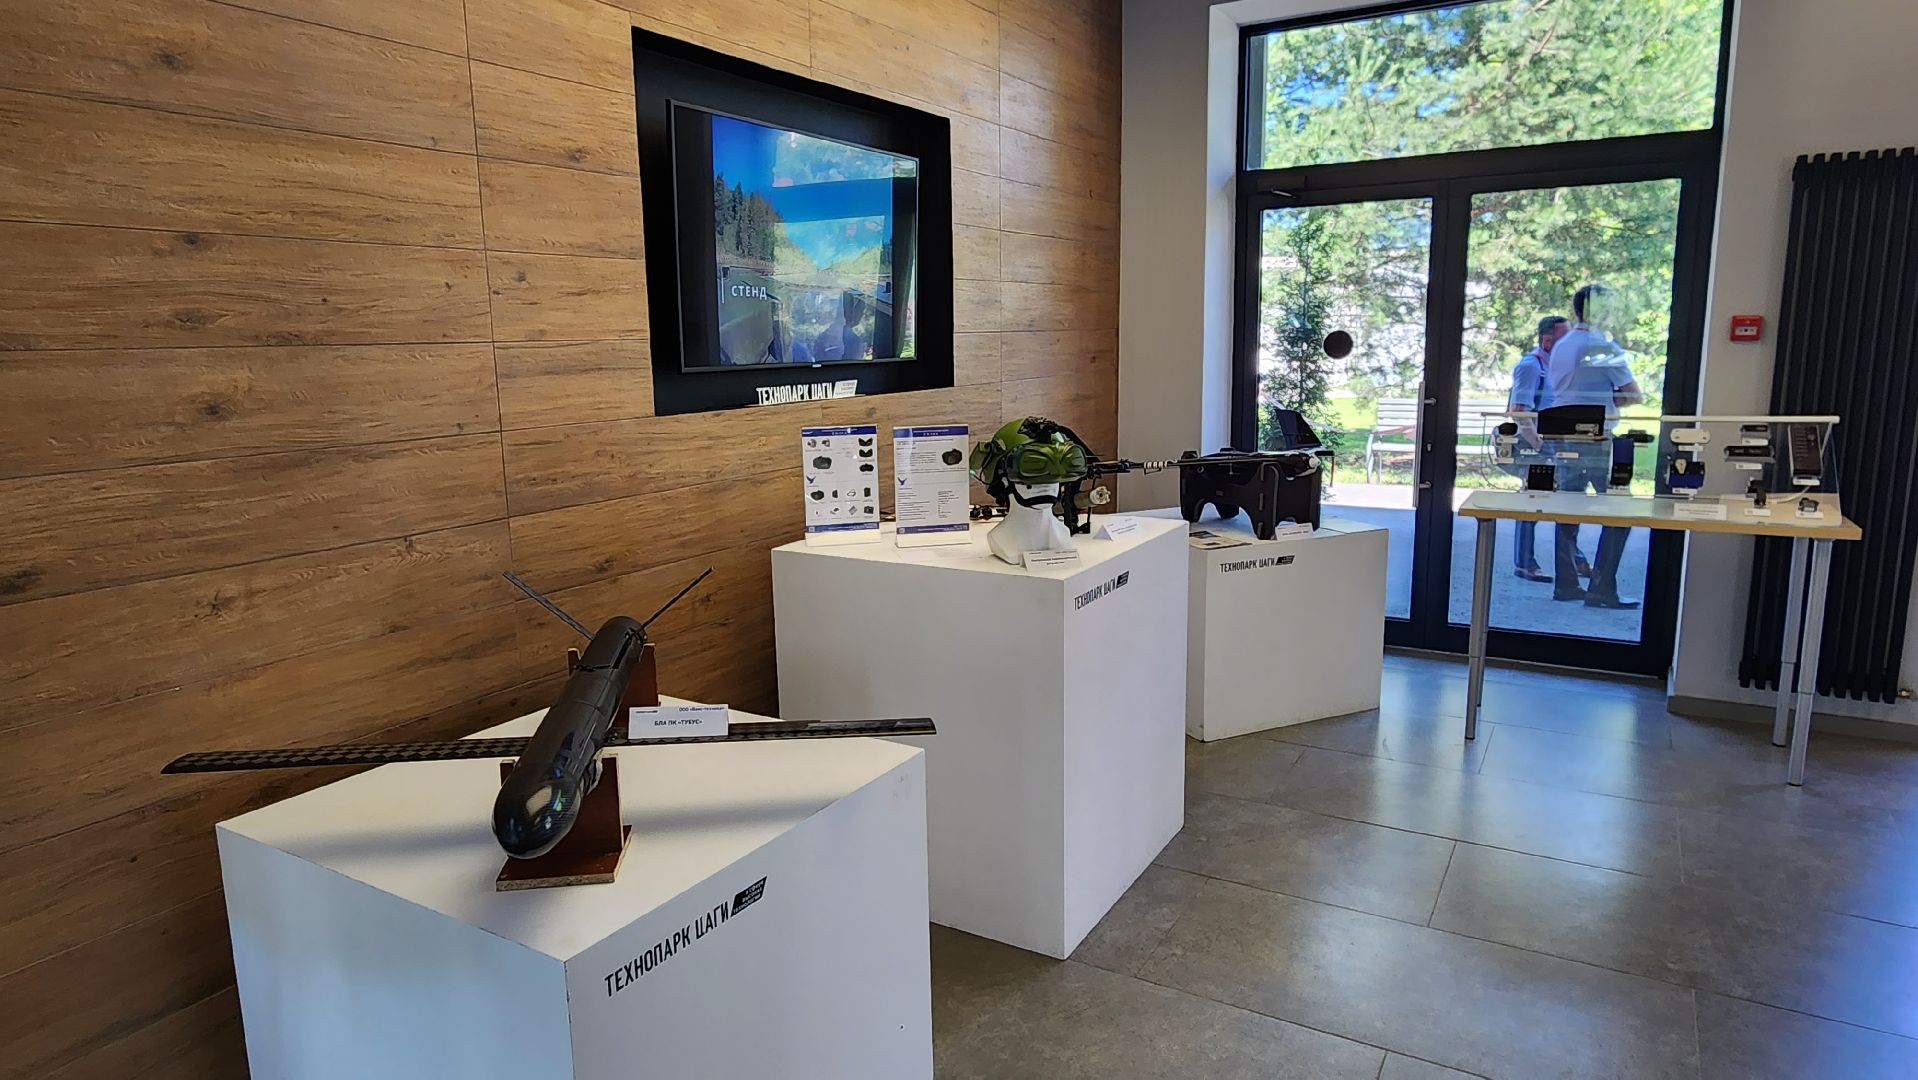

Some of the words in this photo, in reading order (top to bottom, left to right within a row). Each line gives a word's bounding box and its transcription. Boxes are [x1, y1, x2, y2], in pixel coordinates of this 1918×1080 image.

[731, 285, 767, 300] СТЕНД
[756, 384, 809, 405] ТЕХНОПАРК
[811, 382, 833, 400] ЦАГИ
[1220, 559, 1258, 573] ТЕХНОПАРК
[1259, 557, 1275, 568] ЦАГИ
[604, 924, 691, 997] ТЕХНОПАРК
[695, 901, 729, 940] ЦАГИ
